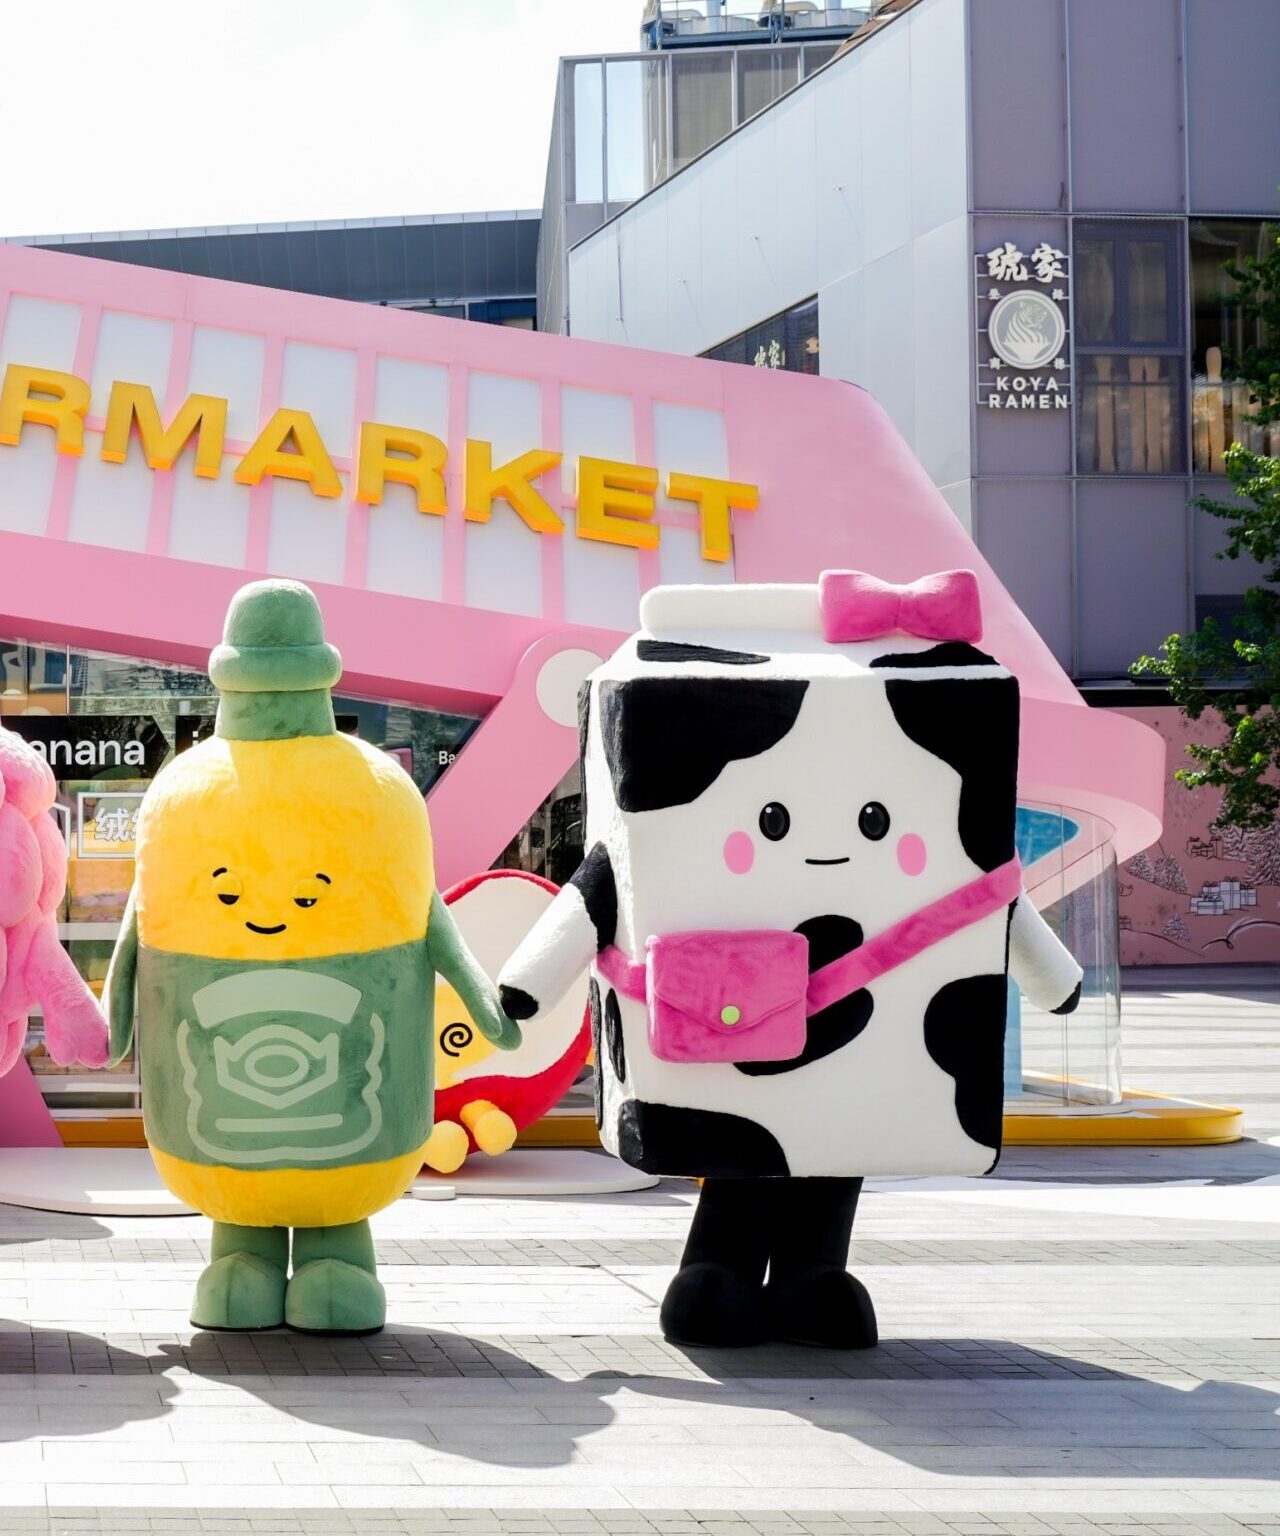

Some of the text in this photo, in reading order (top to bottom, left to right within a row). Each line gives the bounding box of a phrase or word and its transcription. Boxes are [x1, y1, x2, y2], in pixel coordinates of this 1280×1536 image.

[996, 377, 1059, 391] KOYA
[989, 394, 1067, 409] RAMEN
[438, 751, 459, 765] Ba
